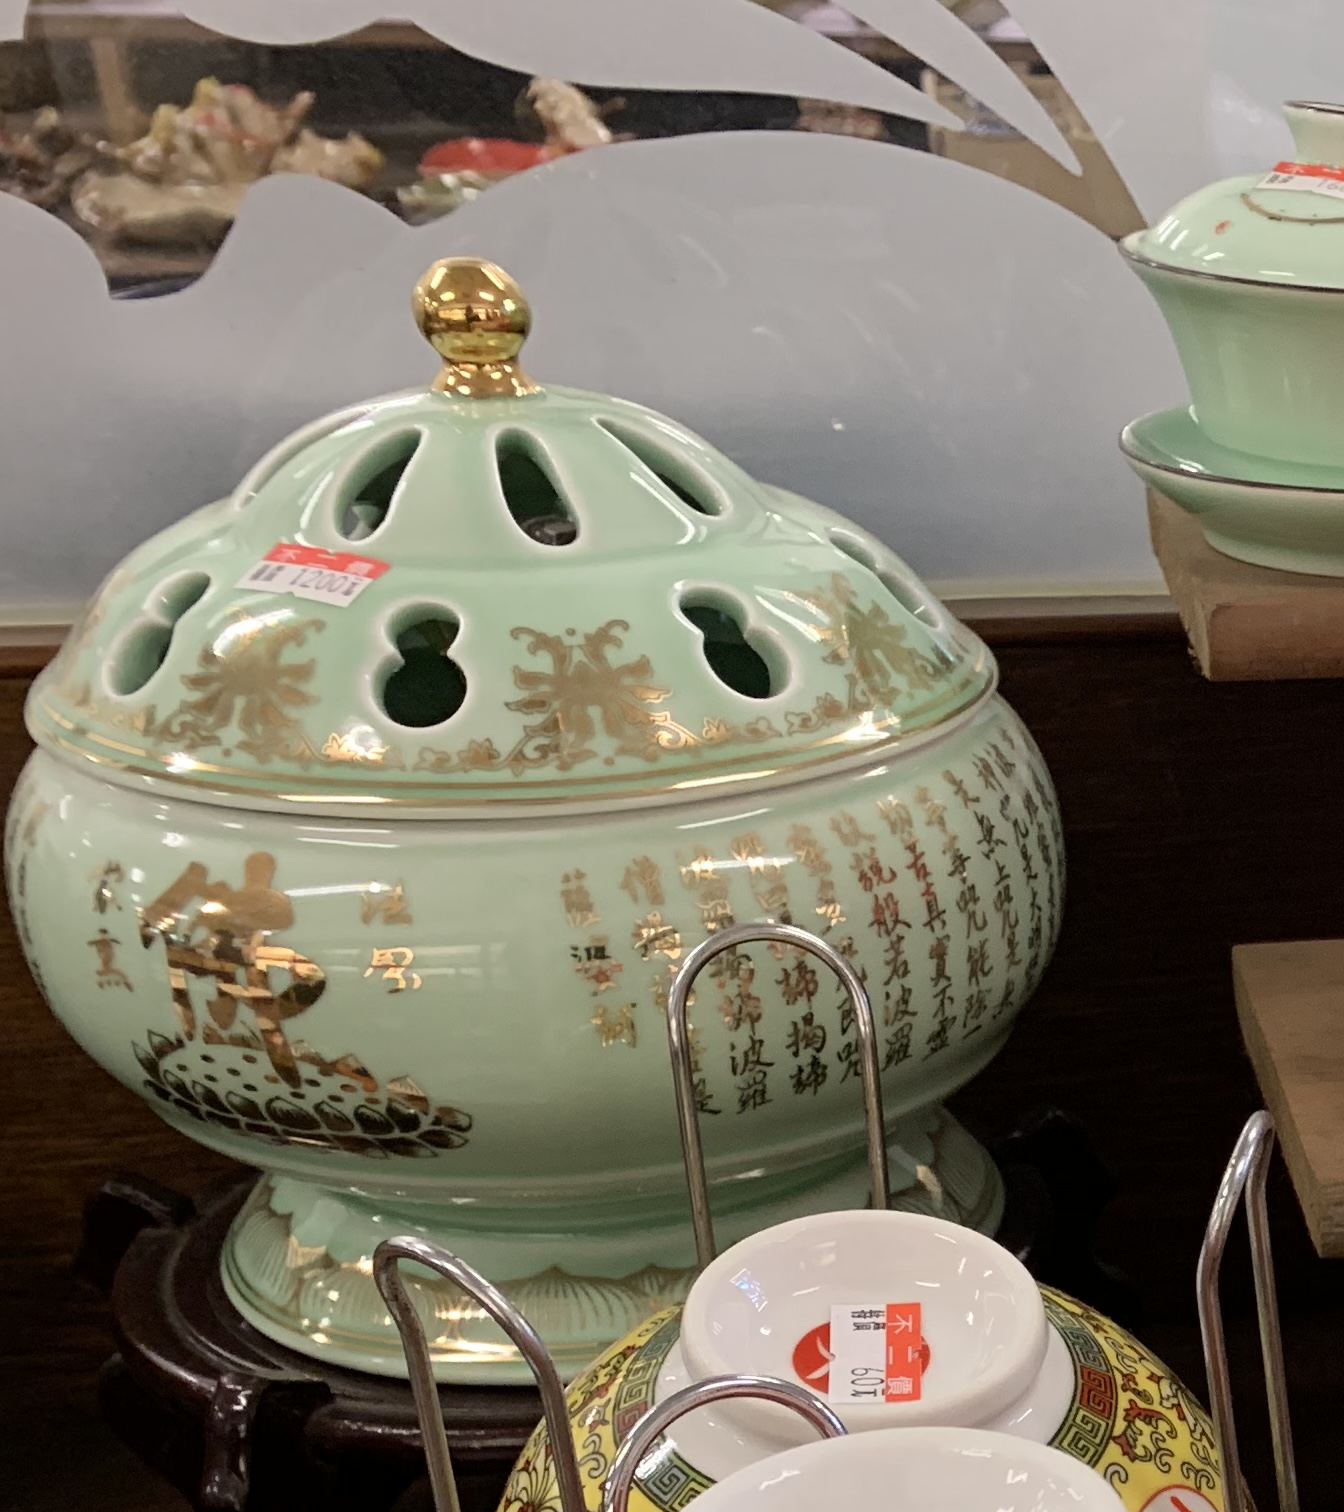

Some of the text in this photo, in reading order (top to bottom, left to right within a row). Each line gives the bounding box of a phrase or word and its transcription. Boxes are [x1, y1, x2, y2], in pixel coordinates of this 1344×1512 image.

[850, 1366, 887, 1398] 60元
[887, 1314, 914, 1396] 不二價
